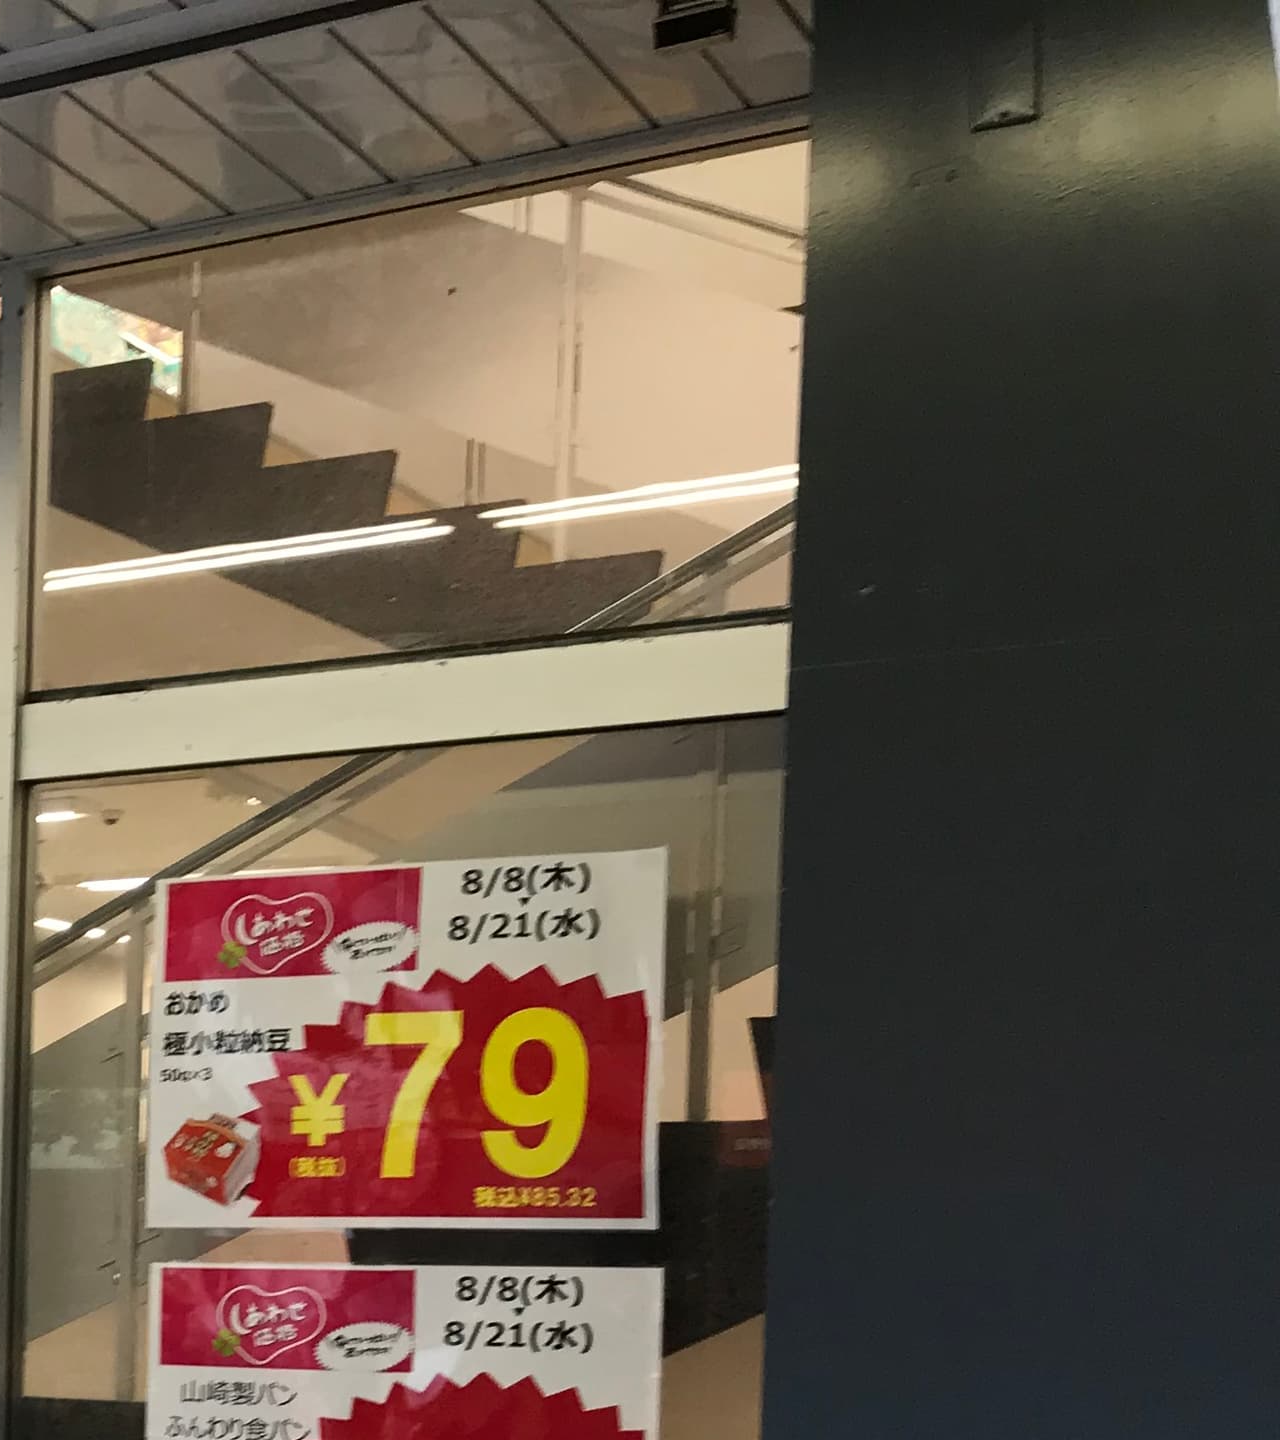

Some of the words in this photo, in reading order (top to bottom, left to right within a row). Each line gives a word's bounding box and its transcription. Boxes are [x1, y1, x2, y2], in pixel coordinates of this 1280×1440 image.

[461, 863, 593, 898] 8/8(木)
[447, 911, 602, 943] 8/21(水)
[164, 1028, 292, 1056] 極小粒納豆
[364, 1007, 590, 1179] 79
[455, 1274, 586, 1306] 8/8(木)
[443, 1320, 594, 1353] 8/21(水)
[180, 1379, 298, 1406] 山崎製パン
